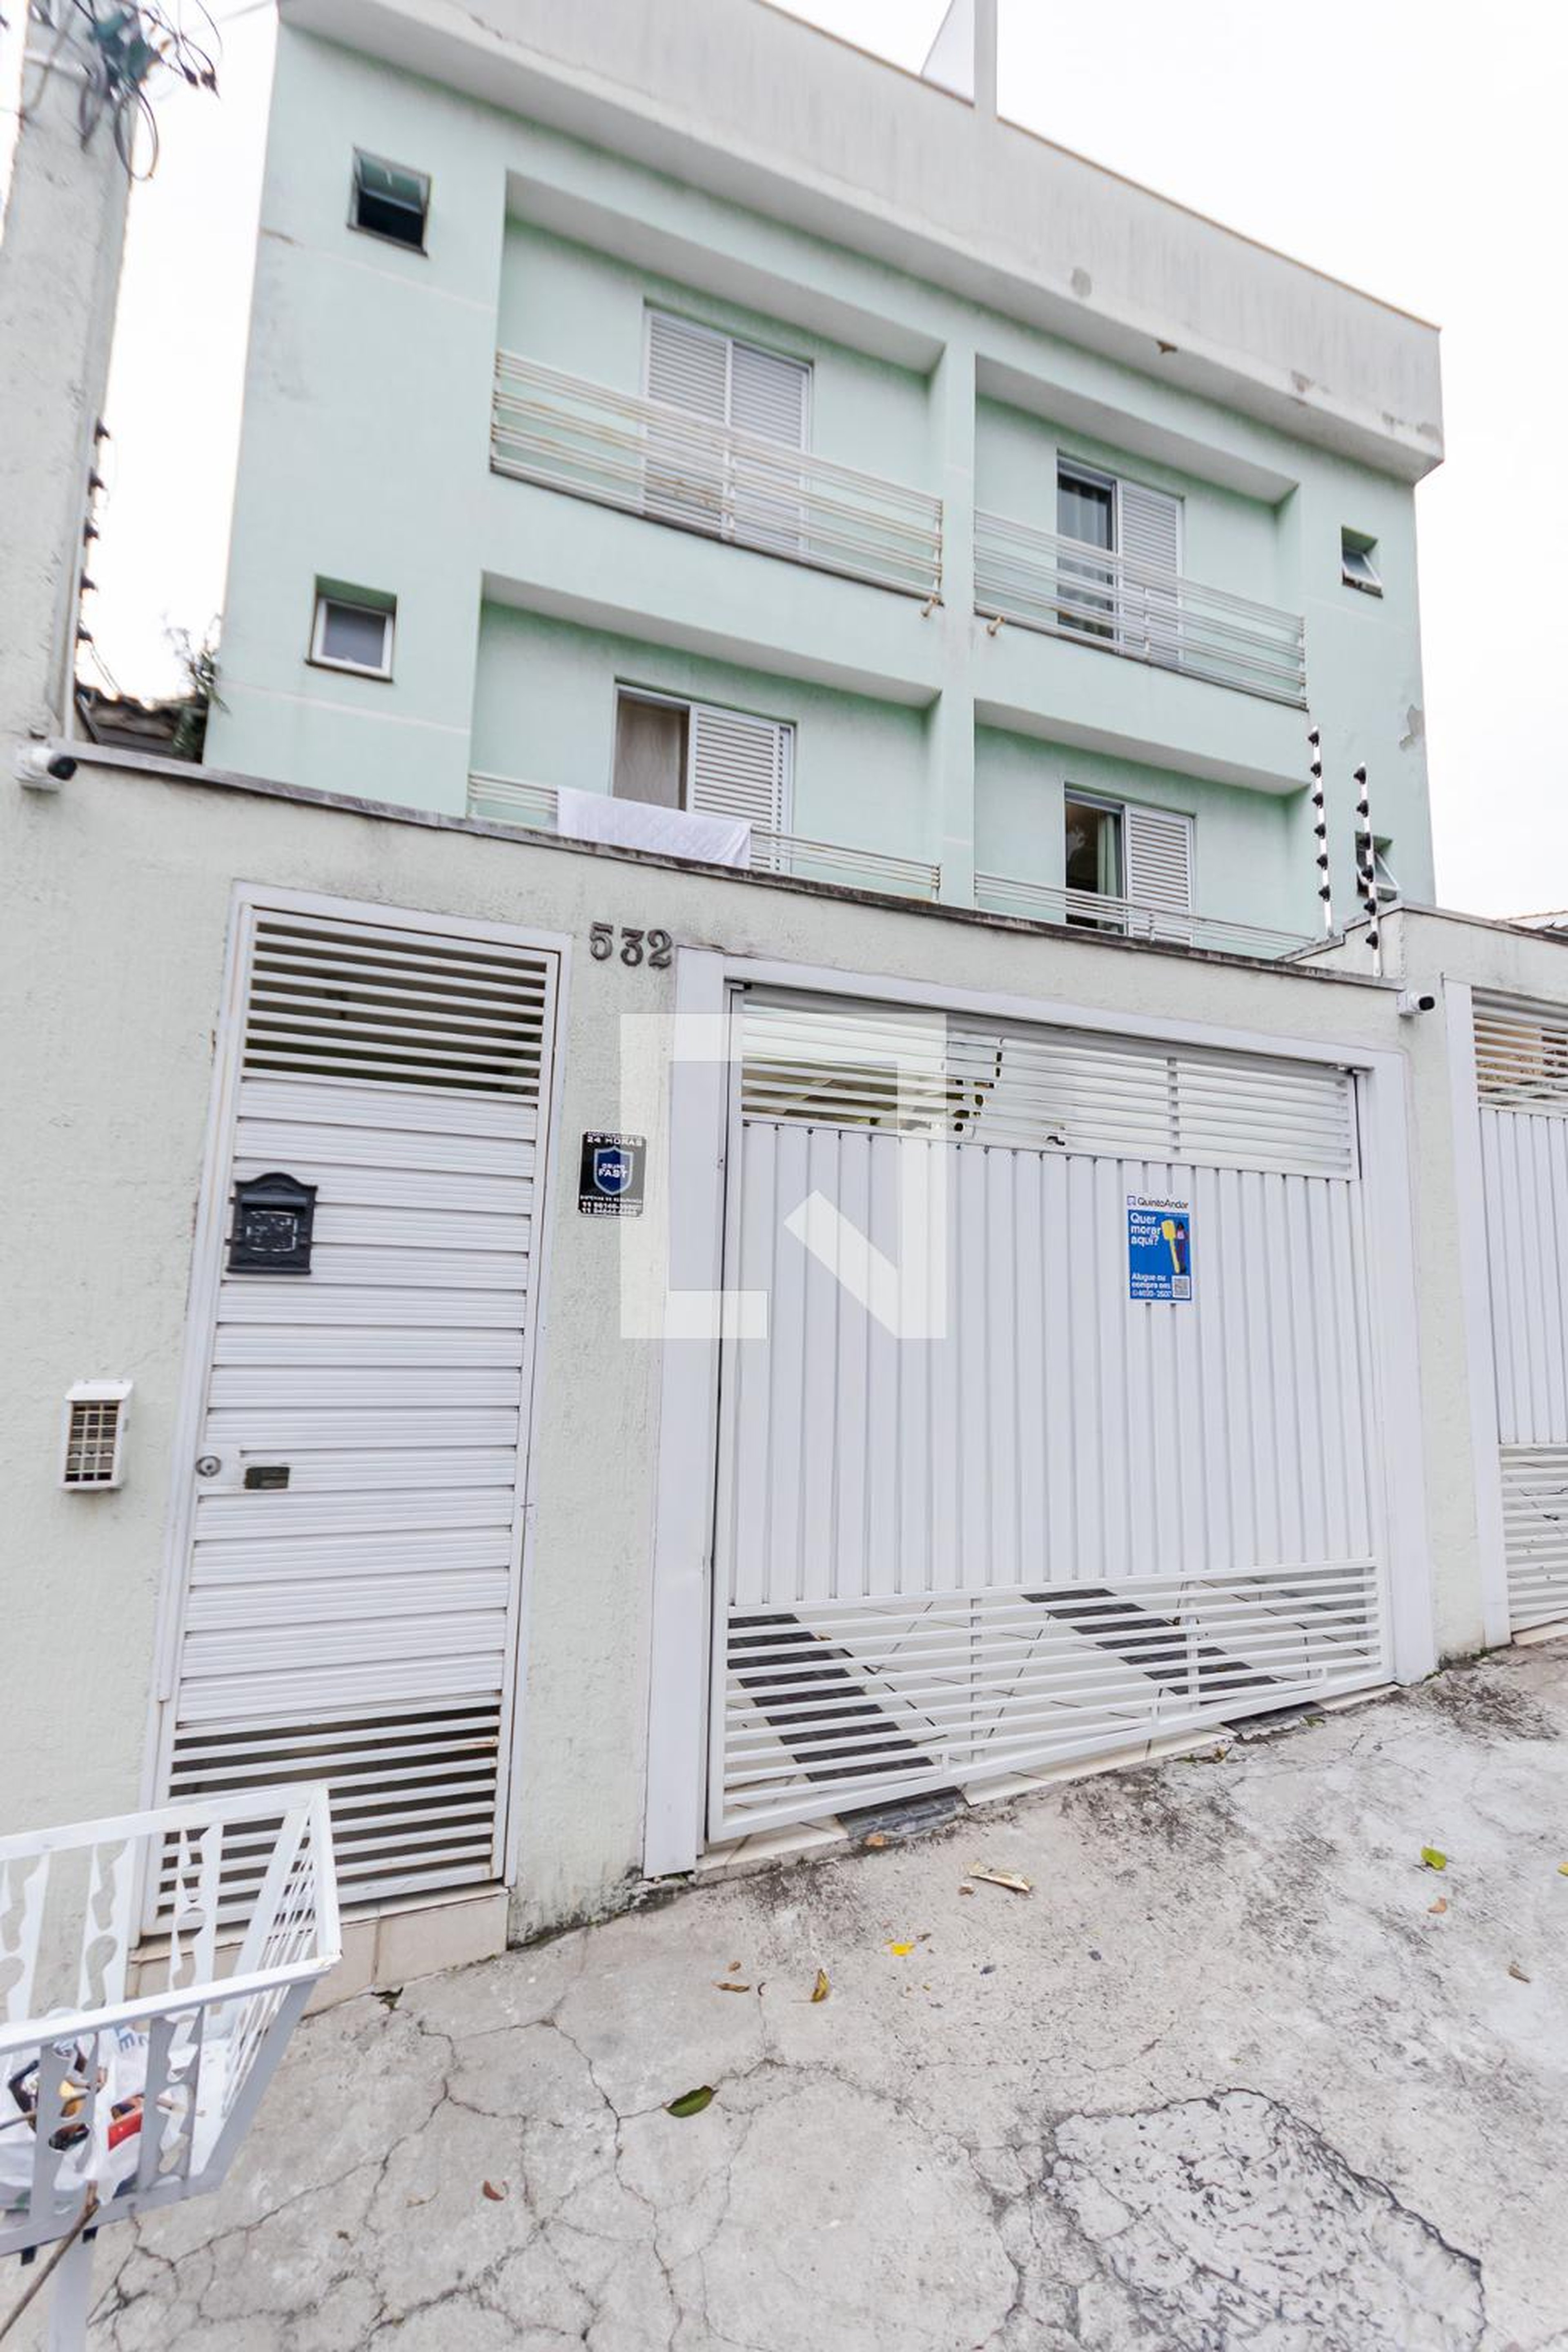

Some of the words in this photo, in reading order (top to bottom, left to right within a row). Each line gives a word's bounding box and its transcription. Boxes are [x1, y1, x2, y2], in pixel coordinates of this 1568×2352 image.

[590, 921, 672, 970] 532
[606, 1138, 642, 1146] HORAS
[599, 1168, 628, 1178] FAST
[1138, 1197, 1188, 1209] QuintoAndar
[1130, 1212, 1156, 1224] Quer
[1131, 1225, 1161, 1235] morar
[1131, 1236, 1159, 1247] aqui?
